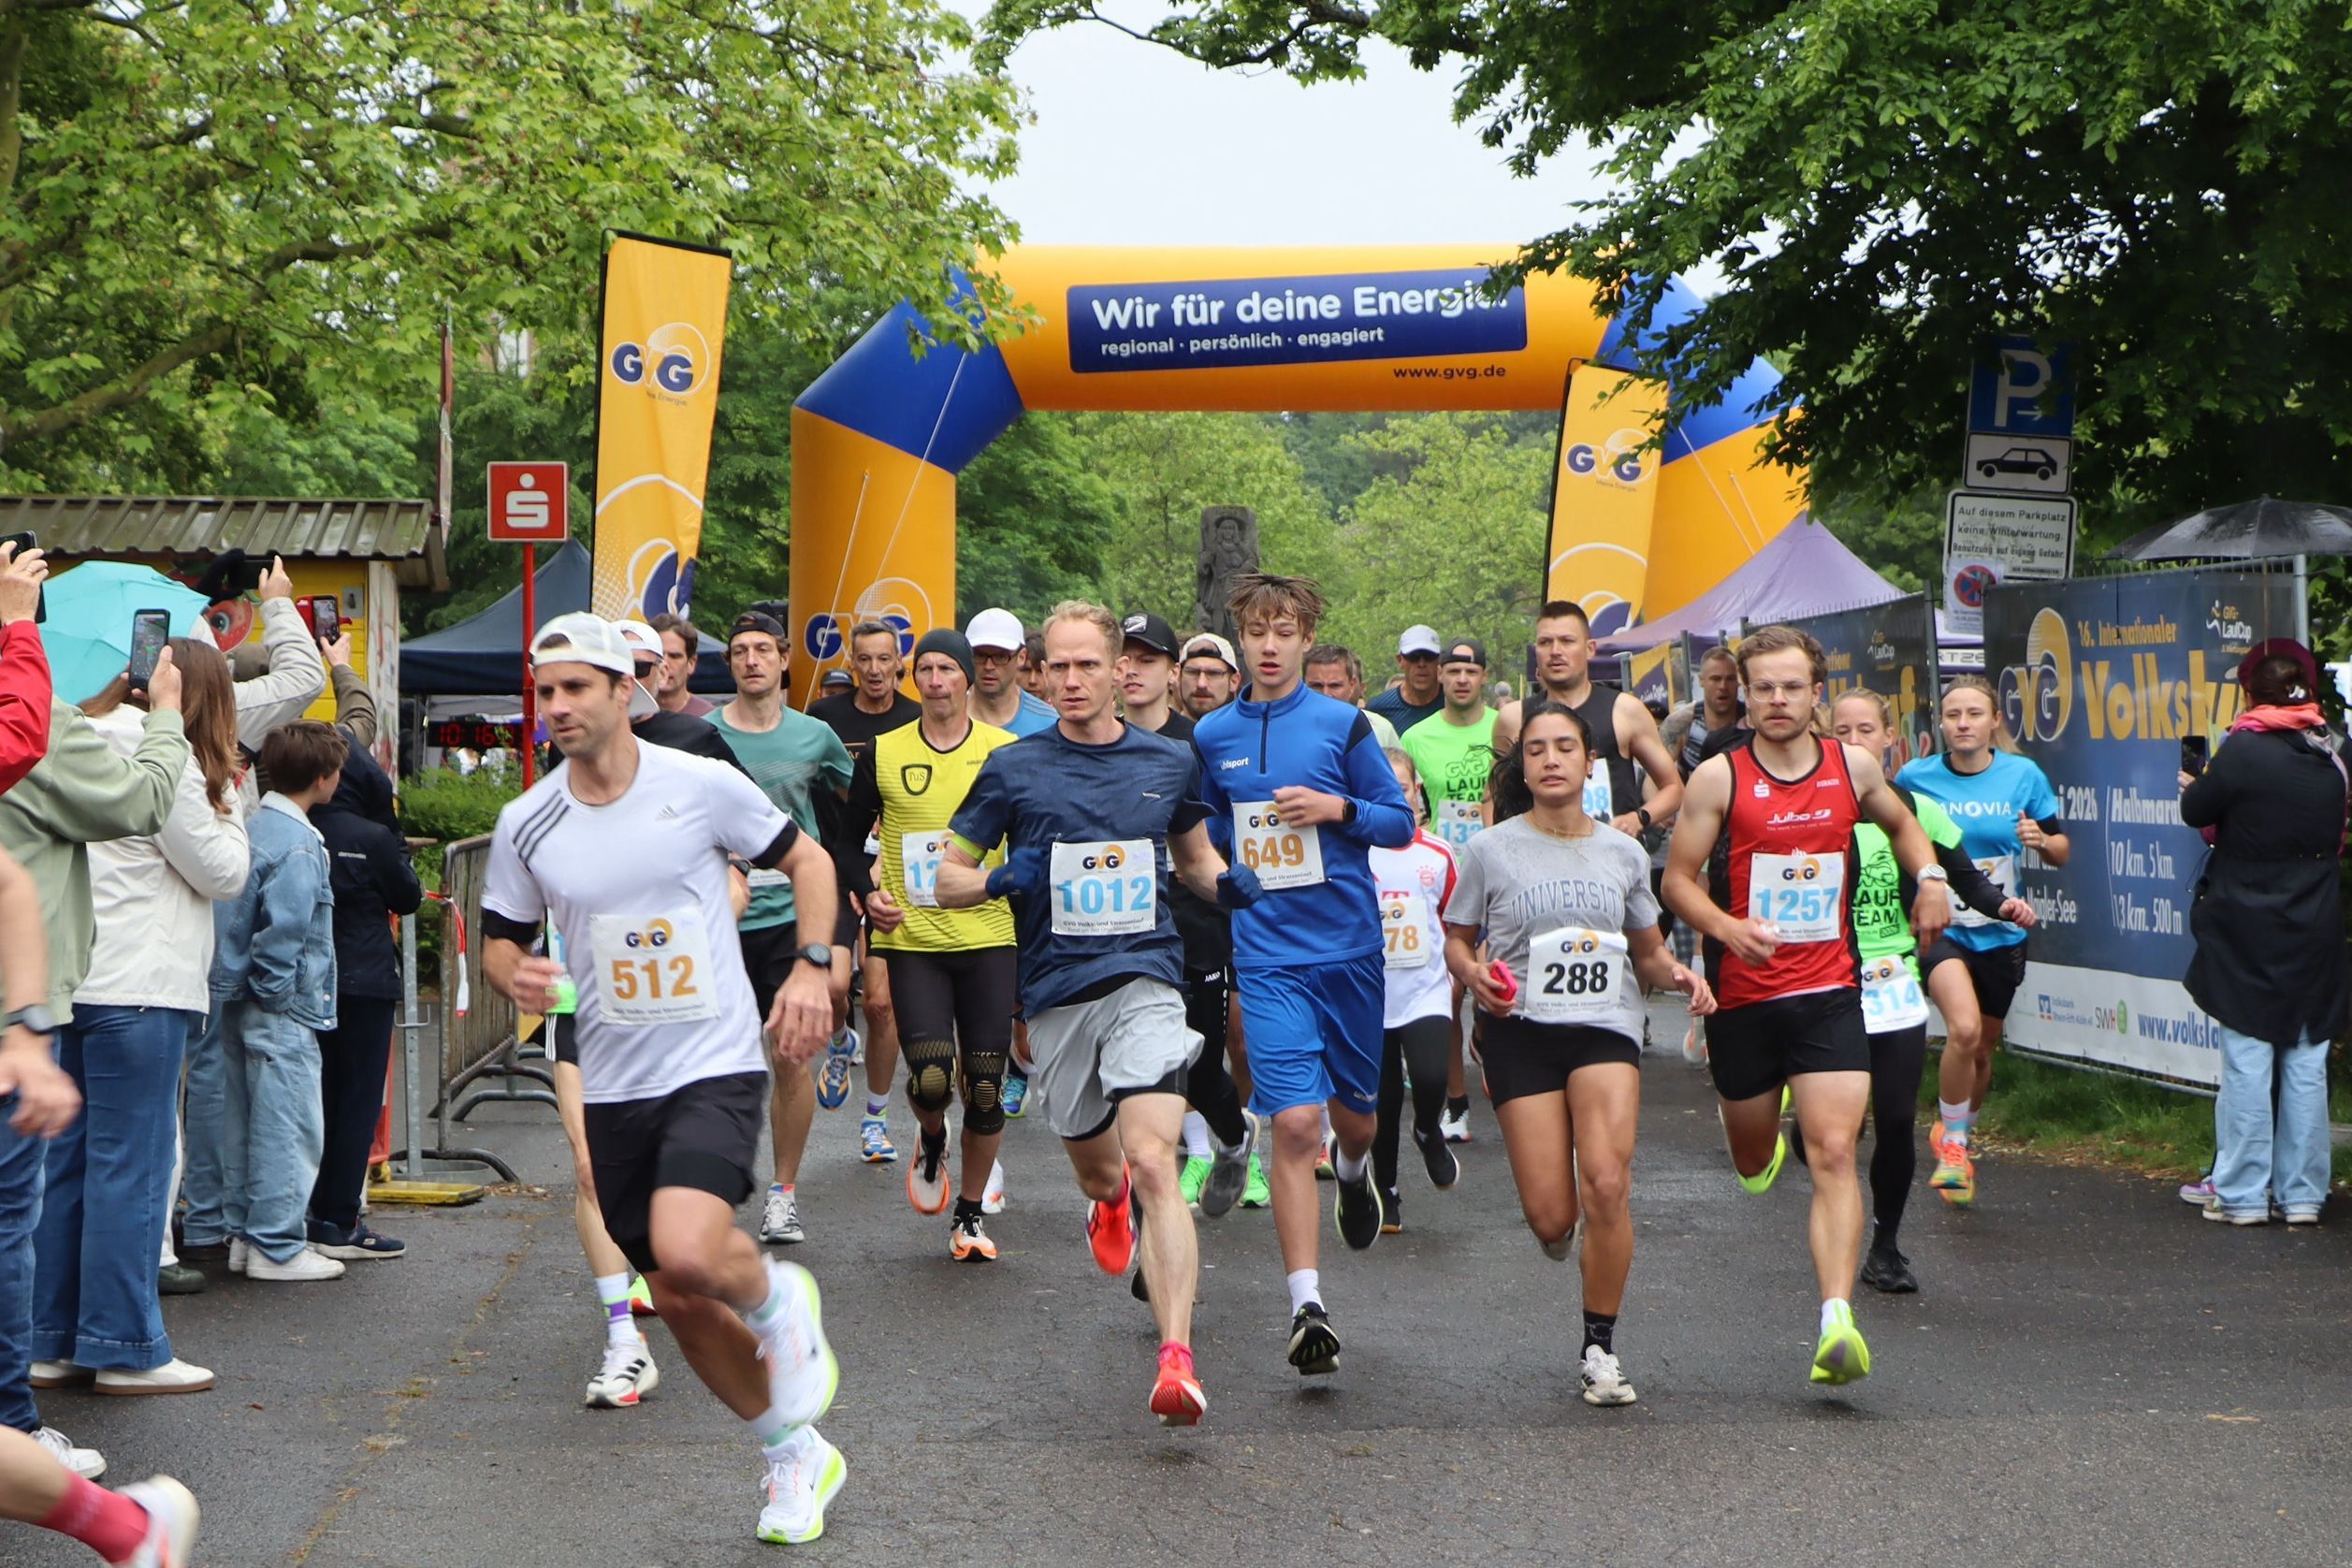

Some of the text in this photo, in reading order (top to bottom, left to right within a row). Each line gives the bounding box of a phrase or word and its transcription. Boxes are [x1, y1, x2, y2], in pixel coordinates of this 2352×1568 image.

[1091, 295, 1160, 330] Wir
[1170, 293, 1224, 326] für
[1236, 289, 1341, 324] deine
[1100, 327, 1384, 356] regional persönlich engagiert
[611, 341, 694, 394] GVG
[1393, 364, 1506, 380] www.gvg.de
[1994, 349, 2052, 428] P
[1566, 443, 1642, 483] GVG
[1957, 524, 1984, 534] keine
[1958, 506, 2067, 522] Auf diesem Parkplatz
[1997, 664, 2062, 743] GVG
[1249, 814, 1280, 829] GVG
[1766, 810, 1811, 824] Julbo
[1082, 854, 1120, 870] GVG
[1242, 833, 1304, 870] 649
[2111, 838, 2175, 880] 10 km. 5 km.
[1782, 867, 1816, 881] GVG
[1056, 876, 1152, 914] 1012
[1511, 879, 1621, 931] UNIVERSIT
[1755, 887, 1838, 922] 1257
[1853, 889, 1901, 907] AUF
[1853, 908, 1899, 926] EAM
[2127, 892, 2149, 932] km.
[2153, 897, 2171, 934] 500
[2172, 910, 2183, 936] m
[626, 930, 668, 949] GVG
[1561, 940, 1595, 954] GVG
[611, 954, 698, 1000] 512
[1543, 961, 1609, 995] 288
[1864, 967, 1891, 981] GVG
